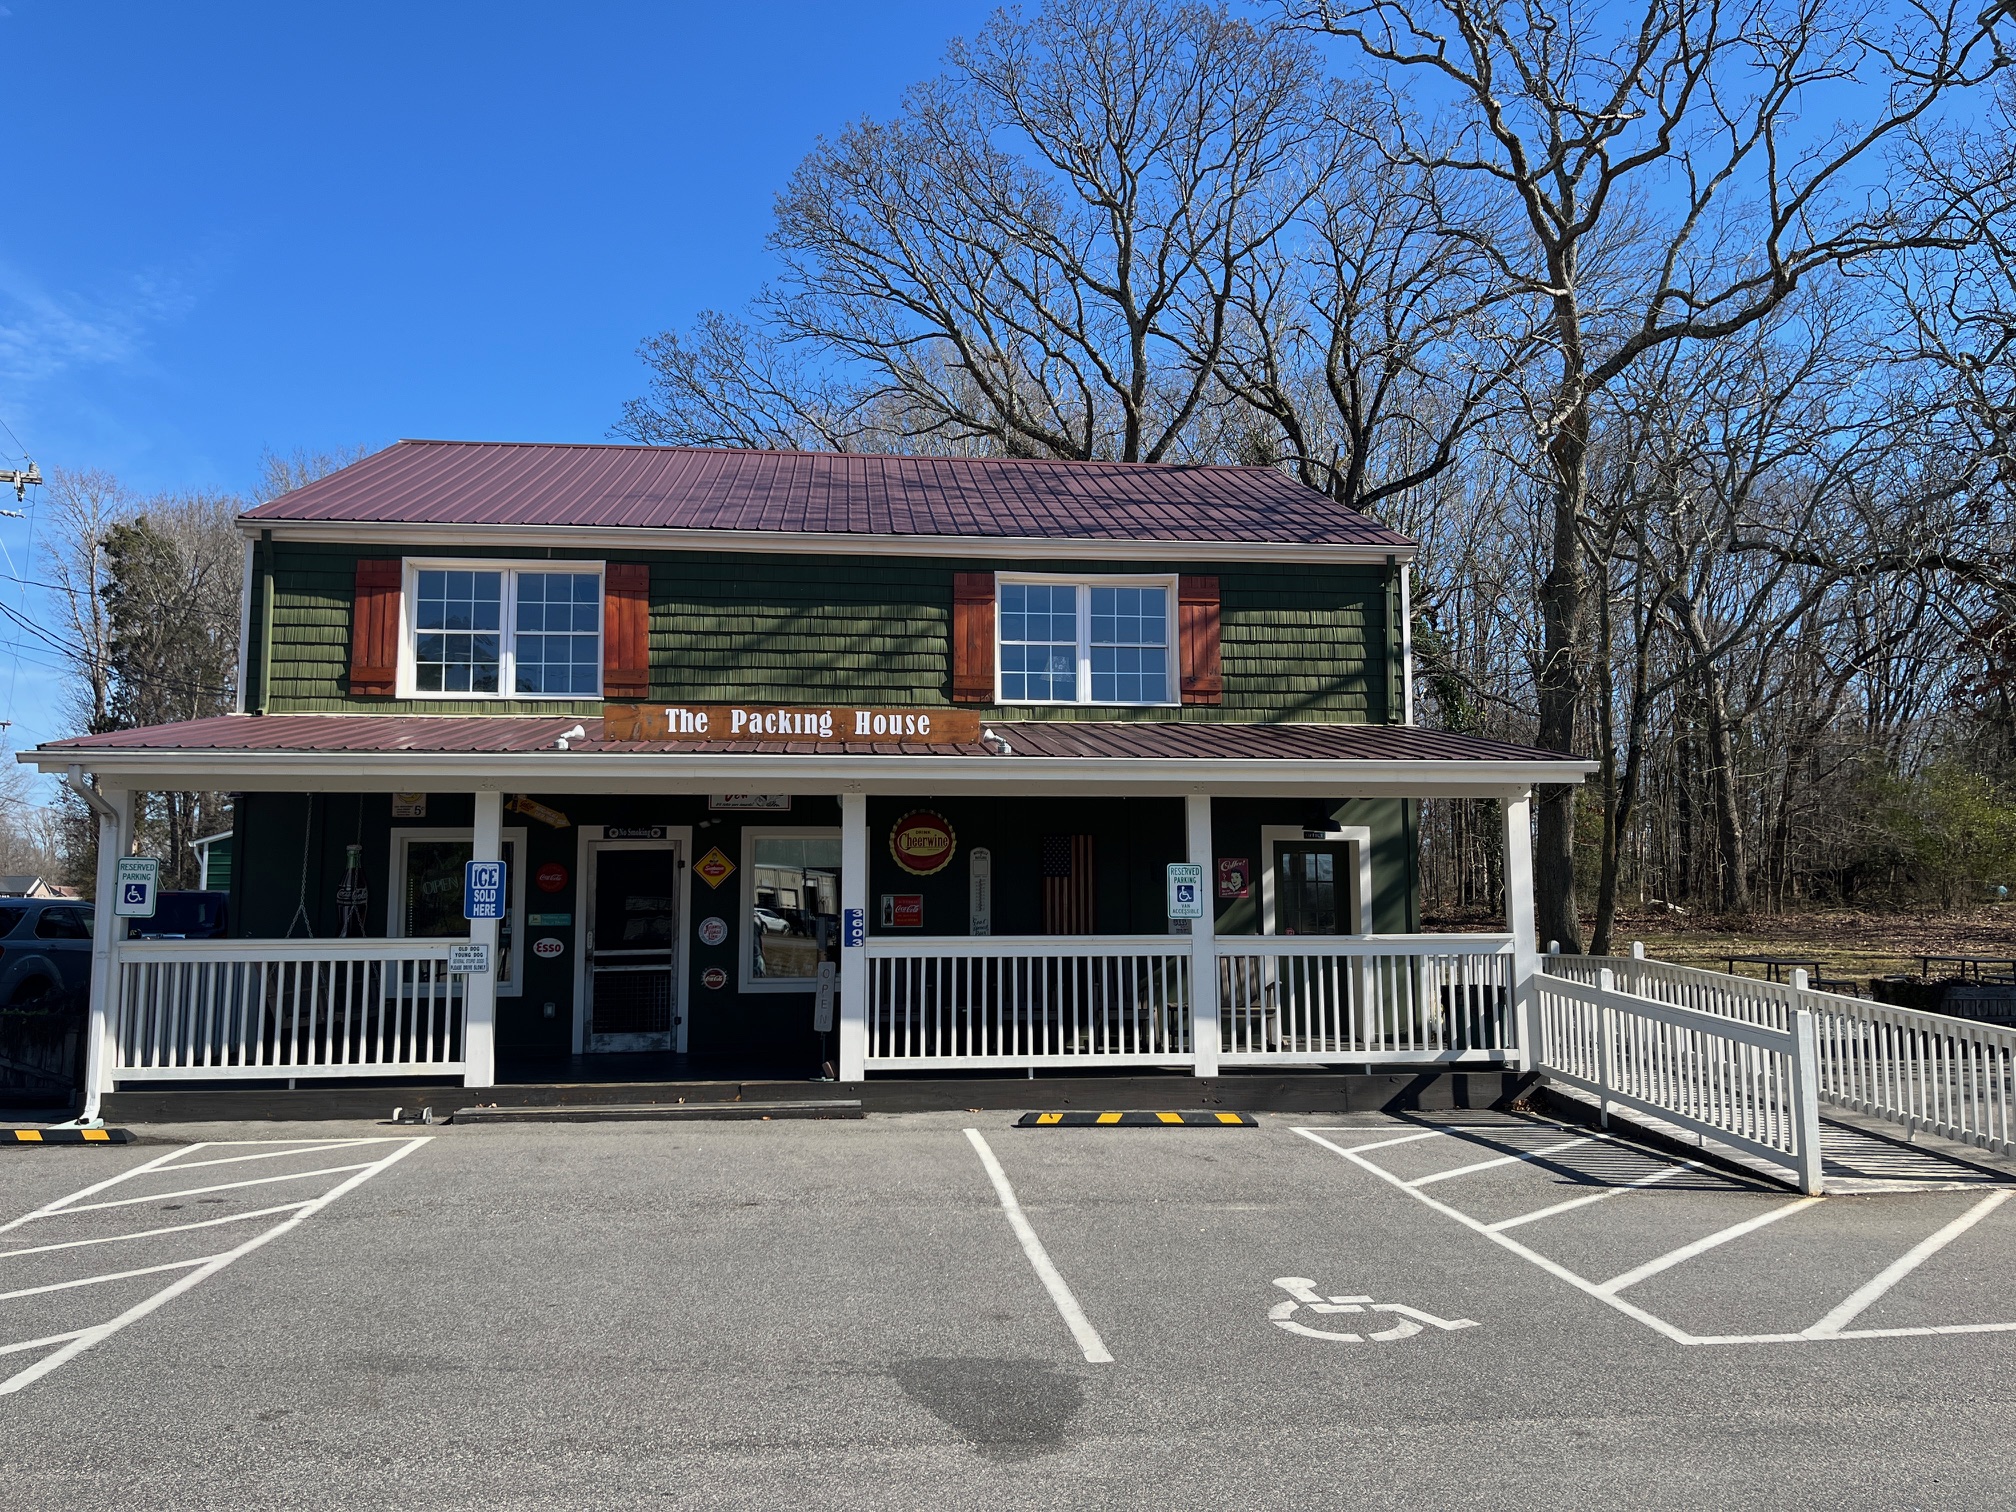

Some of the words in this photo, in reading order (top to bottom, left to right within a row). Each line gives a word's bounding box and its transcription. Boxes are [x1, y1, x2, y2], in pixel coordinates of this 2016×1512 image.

[665, 708, 708, 734] The
[731, 709, 833, 738] Packing
[855, 711, 931, 736] House
[899, 833, 948, 850] Cheerwine
[120, 863, 155, 871] RESERVED
[1170, 867, 1200, 875] RESERVED
[422, 876, 459, 895] OPEN
[473, 867, 498, 887] ICE
[473, 890, 496, 902] SOLD
[473, 904, 496, 916] HERE
[852, 909, 863, 947] 3603
[820, 968, 830, 1024] OPEN
